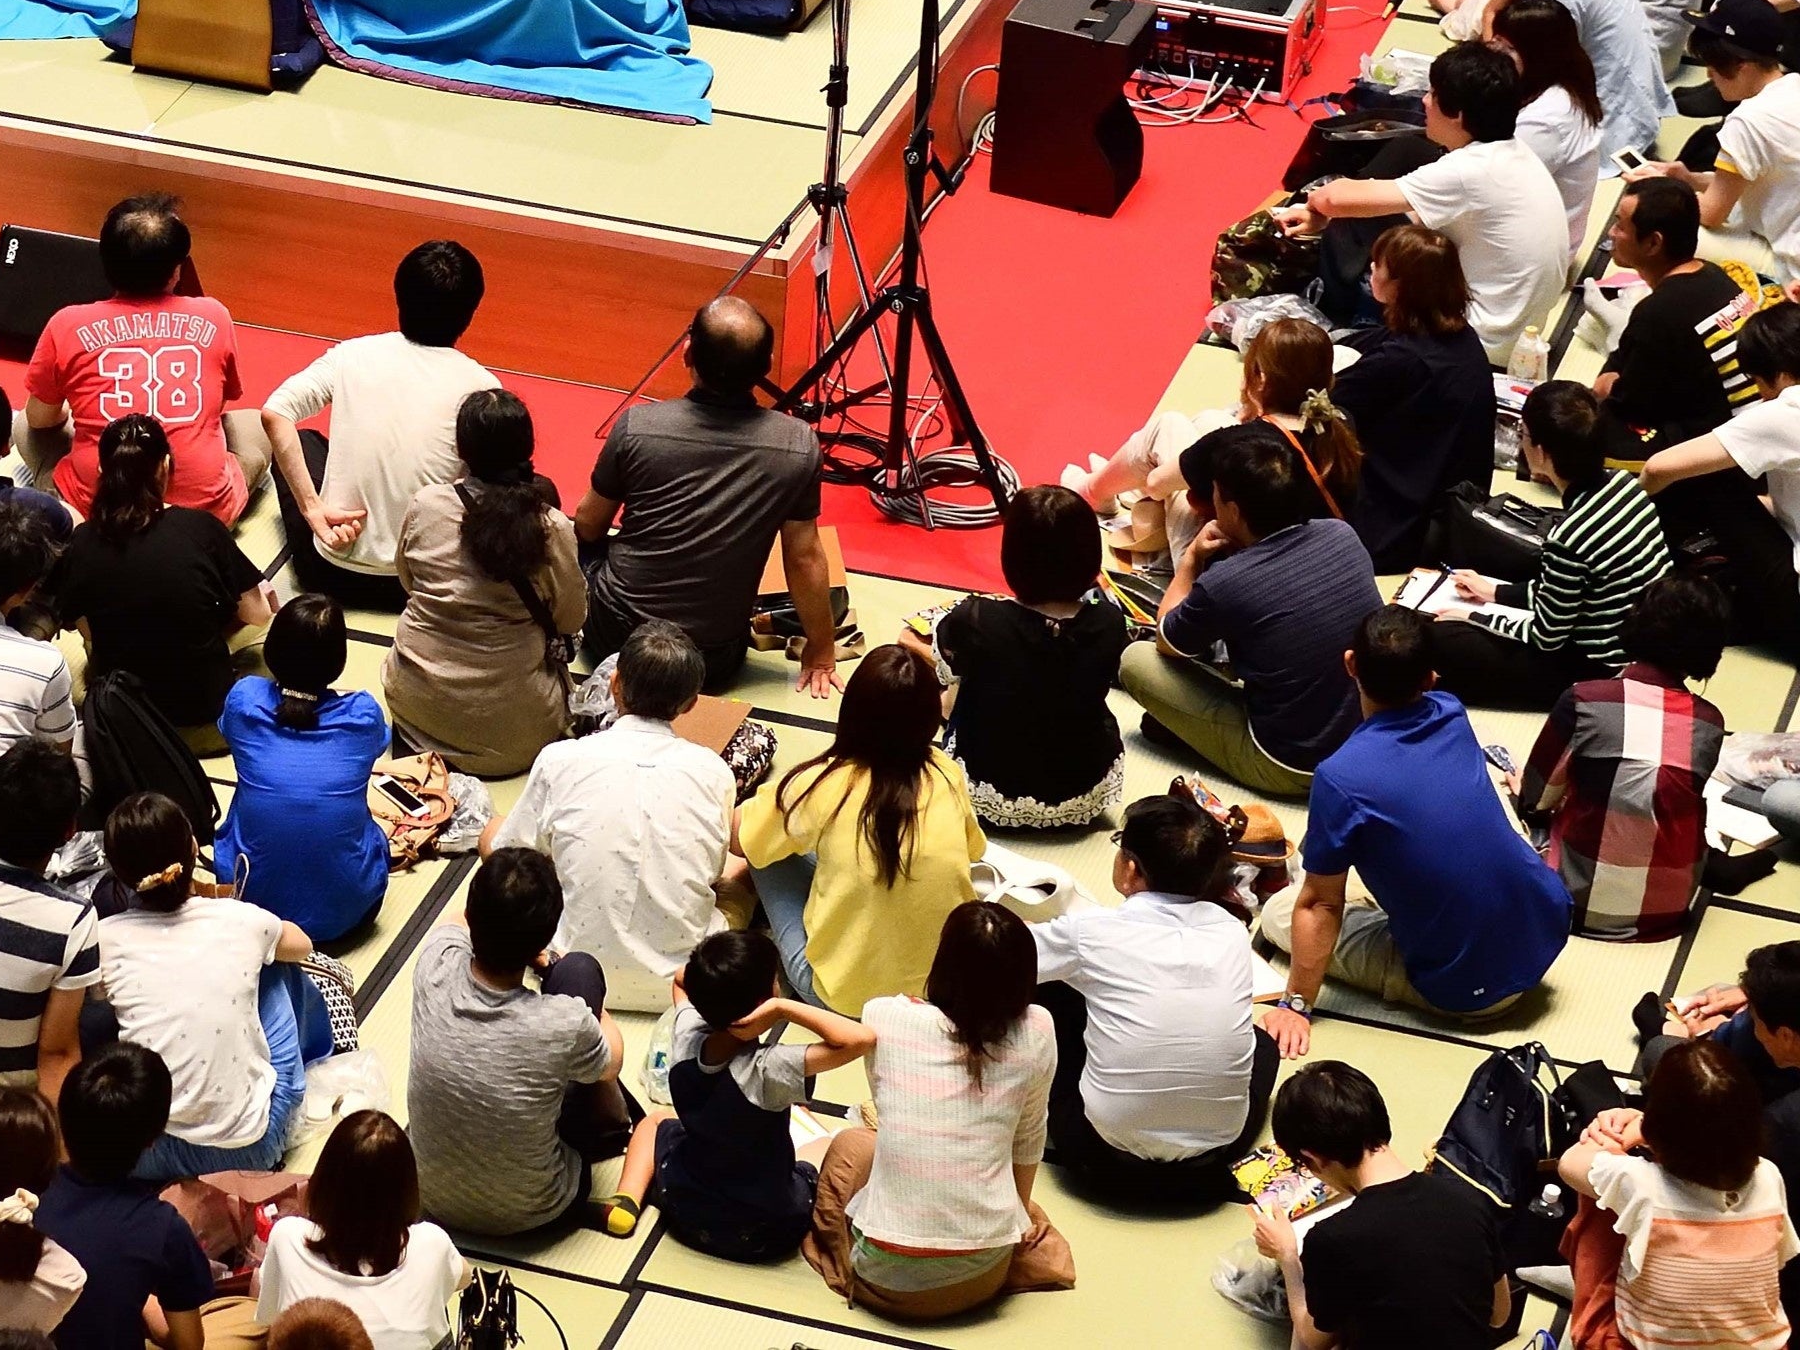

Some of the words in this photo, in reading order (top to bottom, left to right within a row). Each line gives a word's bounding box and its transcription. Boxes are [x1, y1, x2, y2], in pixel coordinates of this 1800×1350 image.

[4, 238, 19, 264] NEXO
[76, 312, 217, 353] AKAMATSU
[98, 344, 203, 423] 38
